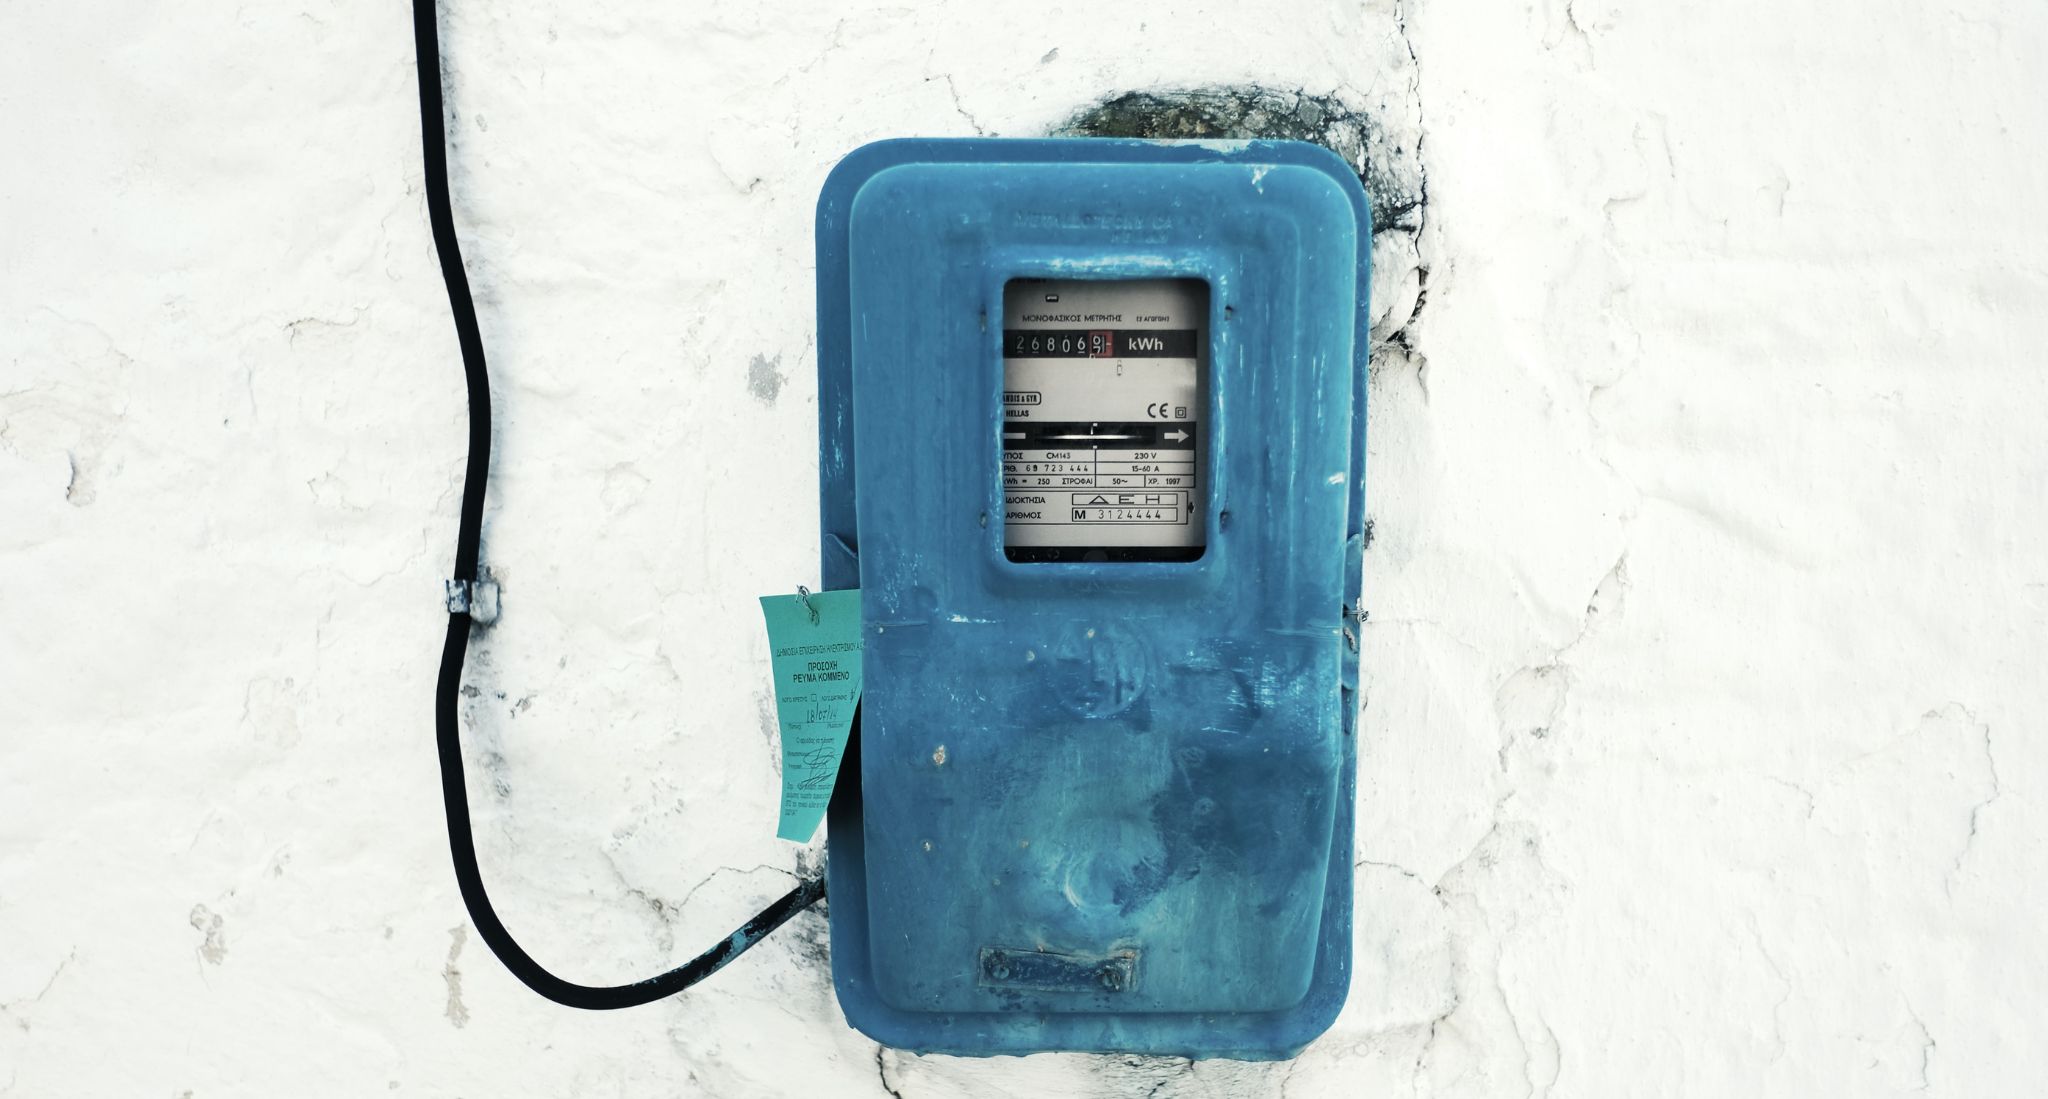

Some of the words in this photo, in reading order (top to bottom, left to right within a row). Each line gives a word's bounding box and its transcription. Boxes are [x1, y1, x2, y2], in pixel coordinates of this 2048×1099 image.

[1022, 314, 1081, 322] ΜΟΝΟΦΑΣΙΚΟΣ
[1084, 314, 1122, 322] ΜΕΤΡΗΤΗΣ
[1128, 337, 1164, 351] kWh
[1005, 409, 1030, 418] HELLAS
[1003, 451, 1024, 460] ΥΠΟΣ
[1046, 452, 1071, 460] CM143
[1134, 452, 1149, 460] 230
[1150, 452, 1157, 460] V
[1003, 464, 1018, 473] ΡΙΘ.
[1131, 465, 1151, 473] 15-60
[1153, 465, 1160, 473] A
[1062, 477, 1093, 485] ΣΤΡΟΦΑΙ
[1089, 494, 1160, 505] ΔΕΗ
[1005, 511, 1042, 520] ΑΡΙΘΜΟΣ
[1074, 509, 1086, 520] M
[807, 660, 838, 671] ΠΡΟΣΟΧΗ
[793, 673, 817, 683] ΡΕΥΜΑ
[818, 671, 850, 682] ΚΟΜΜΕΝΟ
